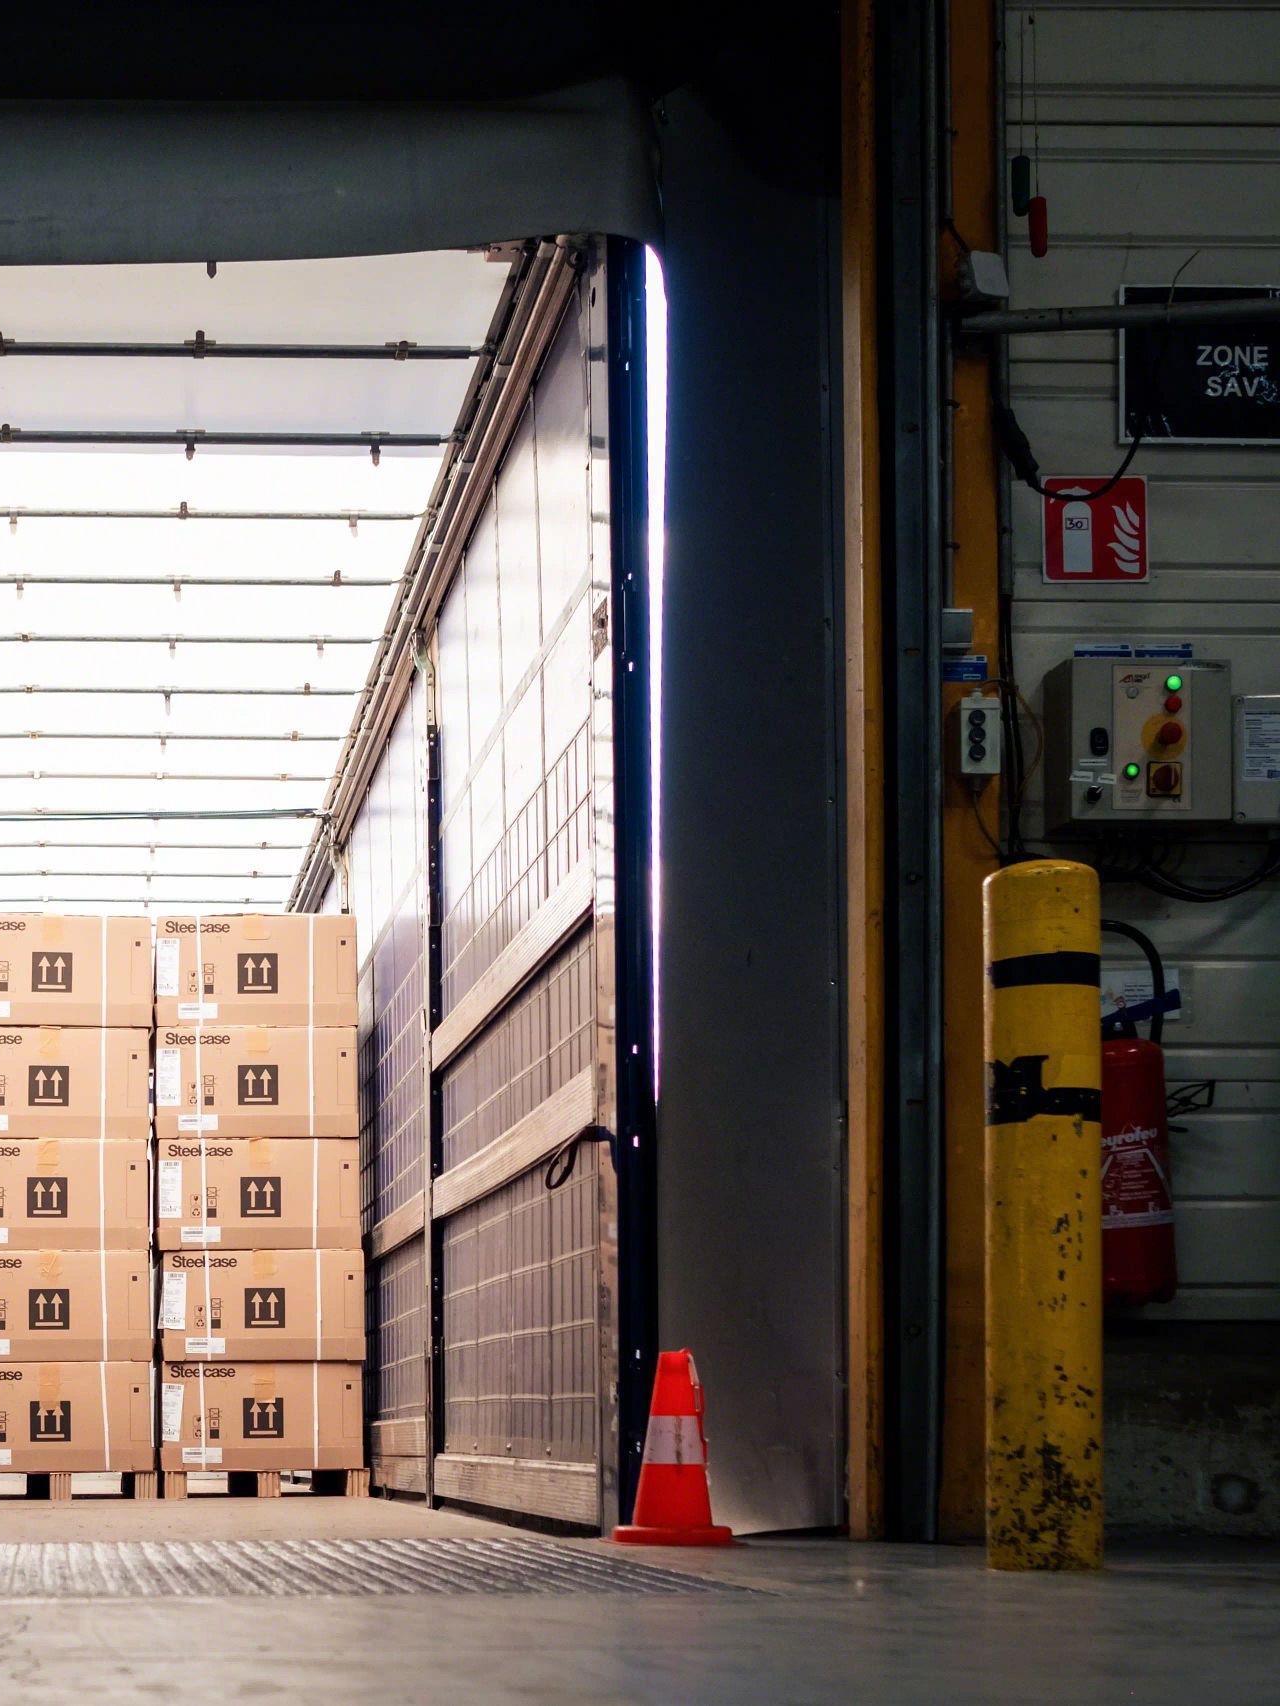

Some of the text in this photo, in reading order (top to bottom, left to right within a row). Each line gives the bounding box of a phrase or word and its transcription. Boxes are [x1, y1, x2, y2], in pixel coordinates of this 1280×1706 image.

[1196, 345, 1269, 366] ZONE
[165, 920, 230, 934] Steecase
[165, 1032, 230, 1045] Steecase
[170, 1365, 236, 1378] Steecase
